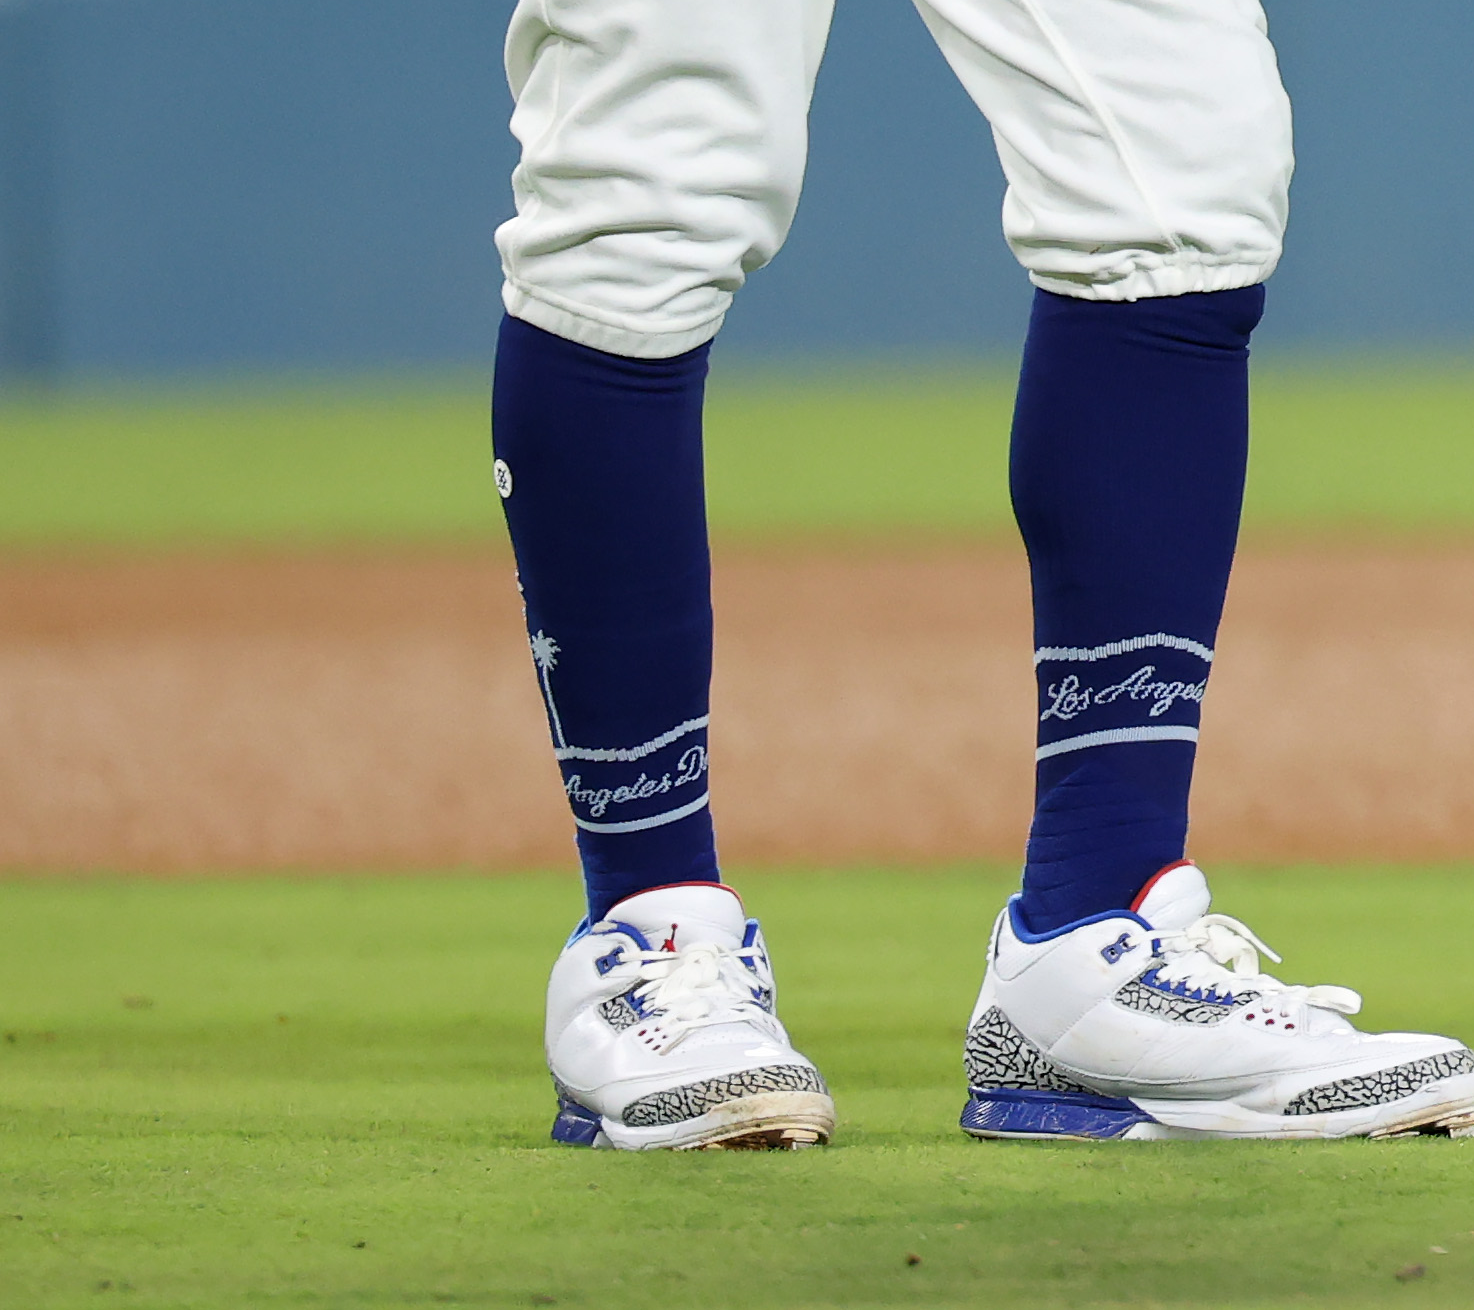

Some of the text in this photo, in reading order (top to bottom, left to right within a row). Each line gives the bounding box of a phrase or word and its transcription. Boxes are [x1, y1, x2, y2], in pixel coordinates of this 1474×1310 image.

[1040, 664, 1207, 721] Los Angele
[565, 773, 672, 818] Angeles
